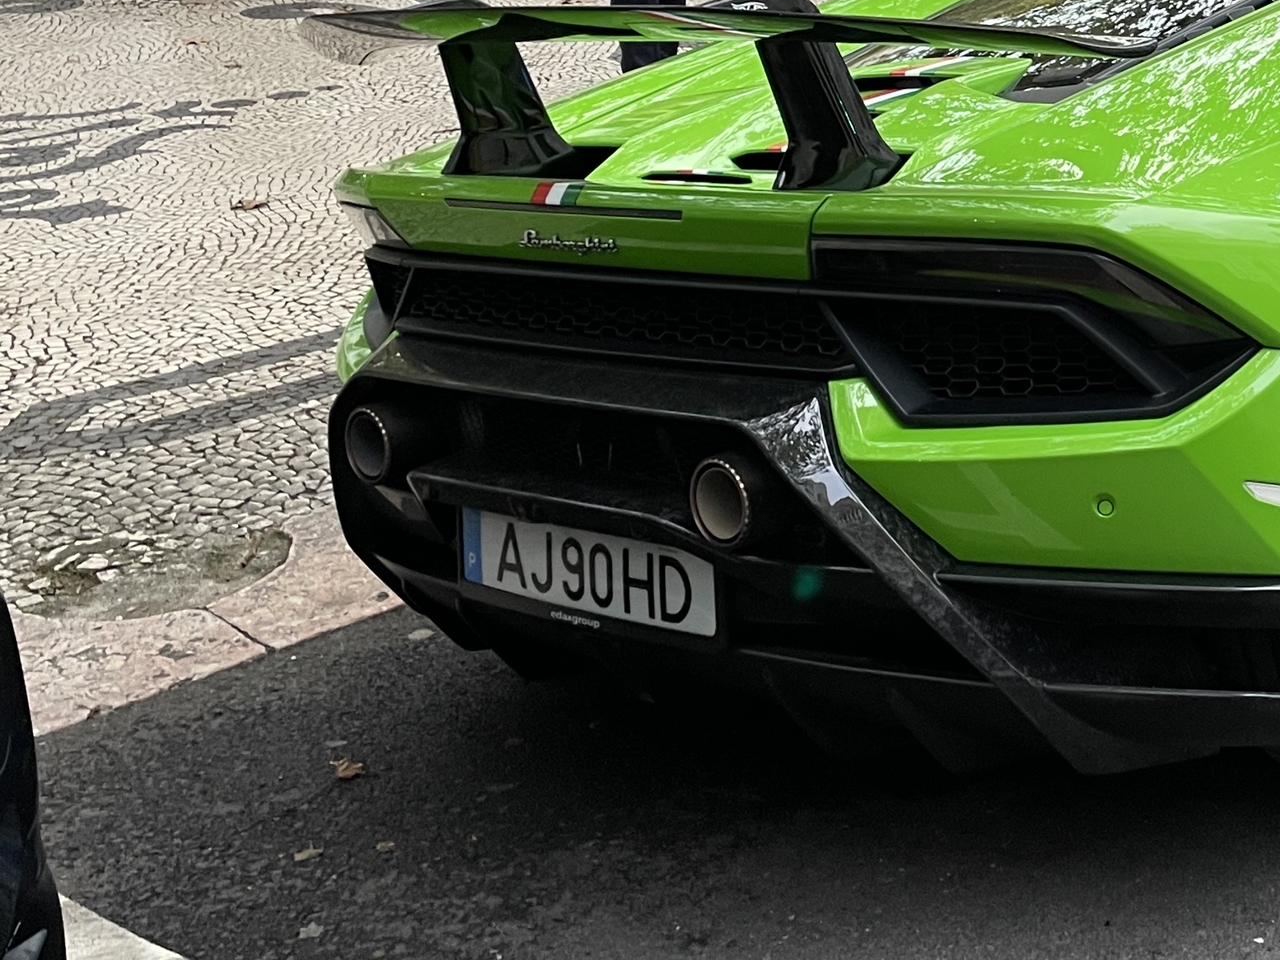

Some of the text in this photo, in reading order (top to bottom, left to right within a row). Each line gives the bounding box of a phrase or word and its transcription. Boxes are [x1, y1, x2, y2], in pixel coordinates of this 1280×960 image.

[519, 229, 618, 256] Lamborghini
[468, 552, 477, 567] P
[497, 522, 692, 624] AJ90HD
[550, 611, 600, 629] edaxgroup
